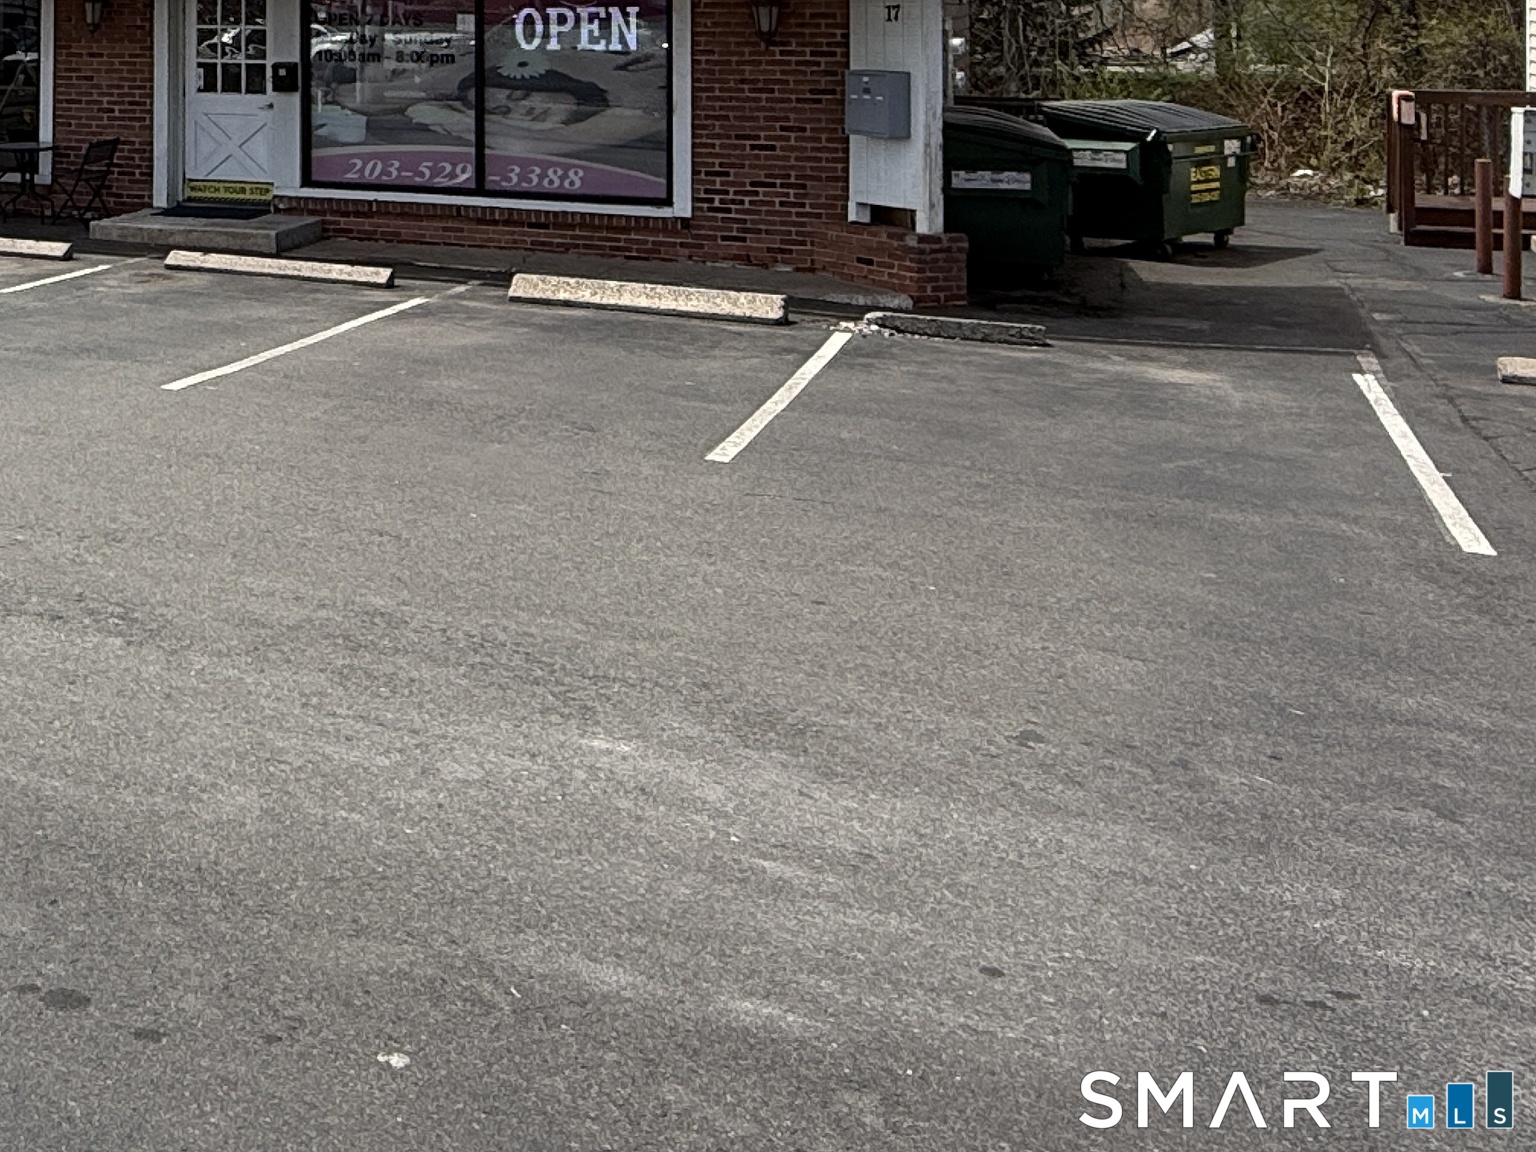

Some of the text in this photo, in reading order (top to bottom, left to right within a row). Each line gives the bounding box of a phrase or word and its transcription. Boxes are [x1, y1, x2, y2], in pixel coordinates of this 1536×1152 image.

[885, 4, 900, 22] 17
[515, 6, 640, 51] OPEN
[189, 185, 271, 196] WATCH YOUR STEP
